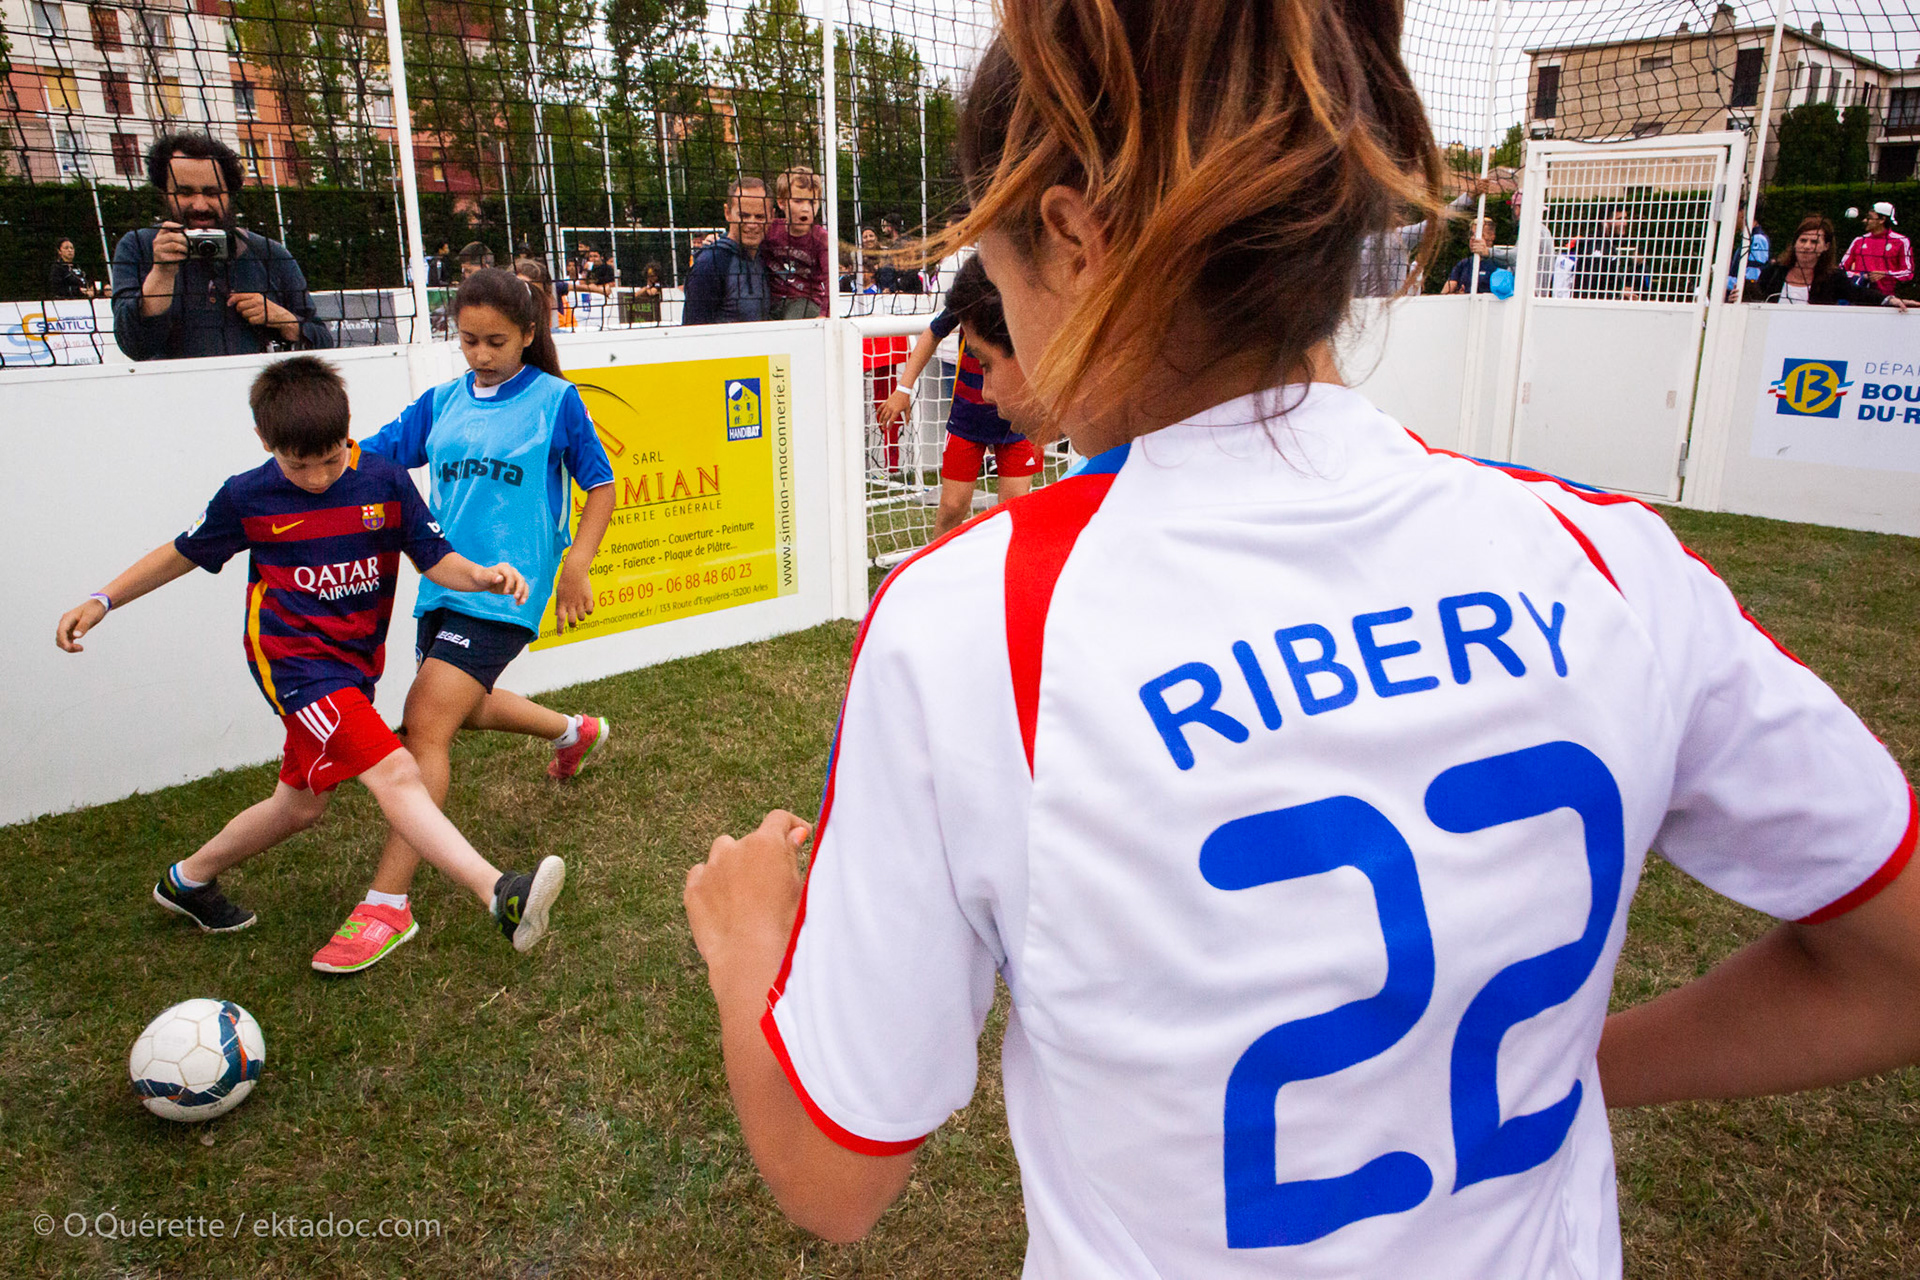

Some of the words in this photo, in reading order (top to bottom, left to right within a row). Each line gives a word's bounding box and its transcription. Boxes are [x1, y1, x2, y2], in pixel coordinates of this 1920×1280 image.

[1865, 361, 1920, 376] DÉPA
[1861, 383, 1920, 402] BOU
[729, 425, 760, 440] HANDIBAT
[632, 451, 664, 465] SARL
[574, 465, 720, 513] MIAN
[772, 366, 792, 586] www.simian-maconnerie.fr
[664, 500, 722, 518] GÉNÉRALE
[610, 537, 660, 555] Rénovation
[668, 528, 714, 545] Couverture
[721, 521, 754, 535] Peinture
[294, 556, 379, 592] QATAR
[623, 556, 655, 570] Faïence
[664, 548, 693, 562] Plaque
[694, 545, 705, 556] de
[318, 577, 380, 600] AIRWAYS
[599, 590, 615, 607] 63
[618, 586, 634, 603] 69
[637, 582, 654, 600] 09
[666, 576, 682, 594] 06
[685, 573, 701, 590] 88
[703, 569, 718, 585] 48
[721, 566, 736, 582] 60
[739, 562, 752, 579] 23
[540, 606, 652, 639] contt@simian-maconnerie.fr
[672, 600, 692, 610] Route
[752, 583, 769, 592] Arles
[1138, 591, 1566, 771] RIBERY
[1199, 740, 1625, 1249] 22
